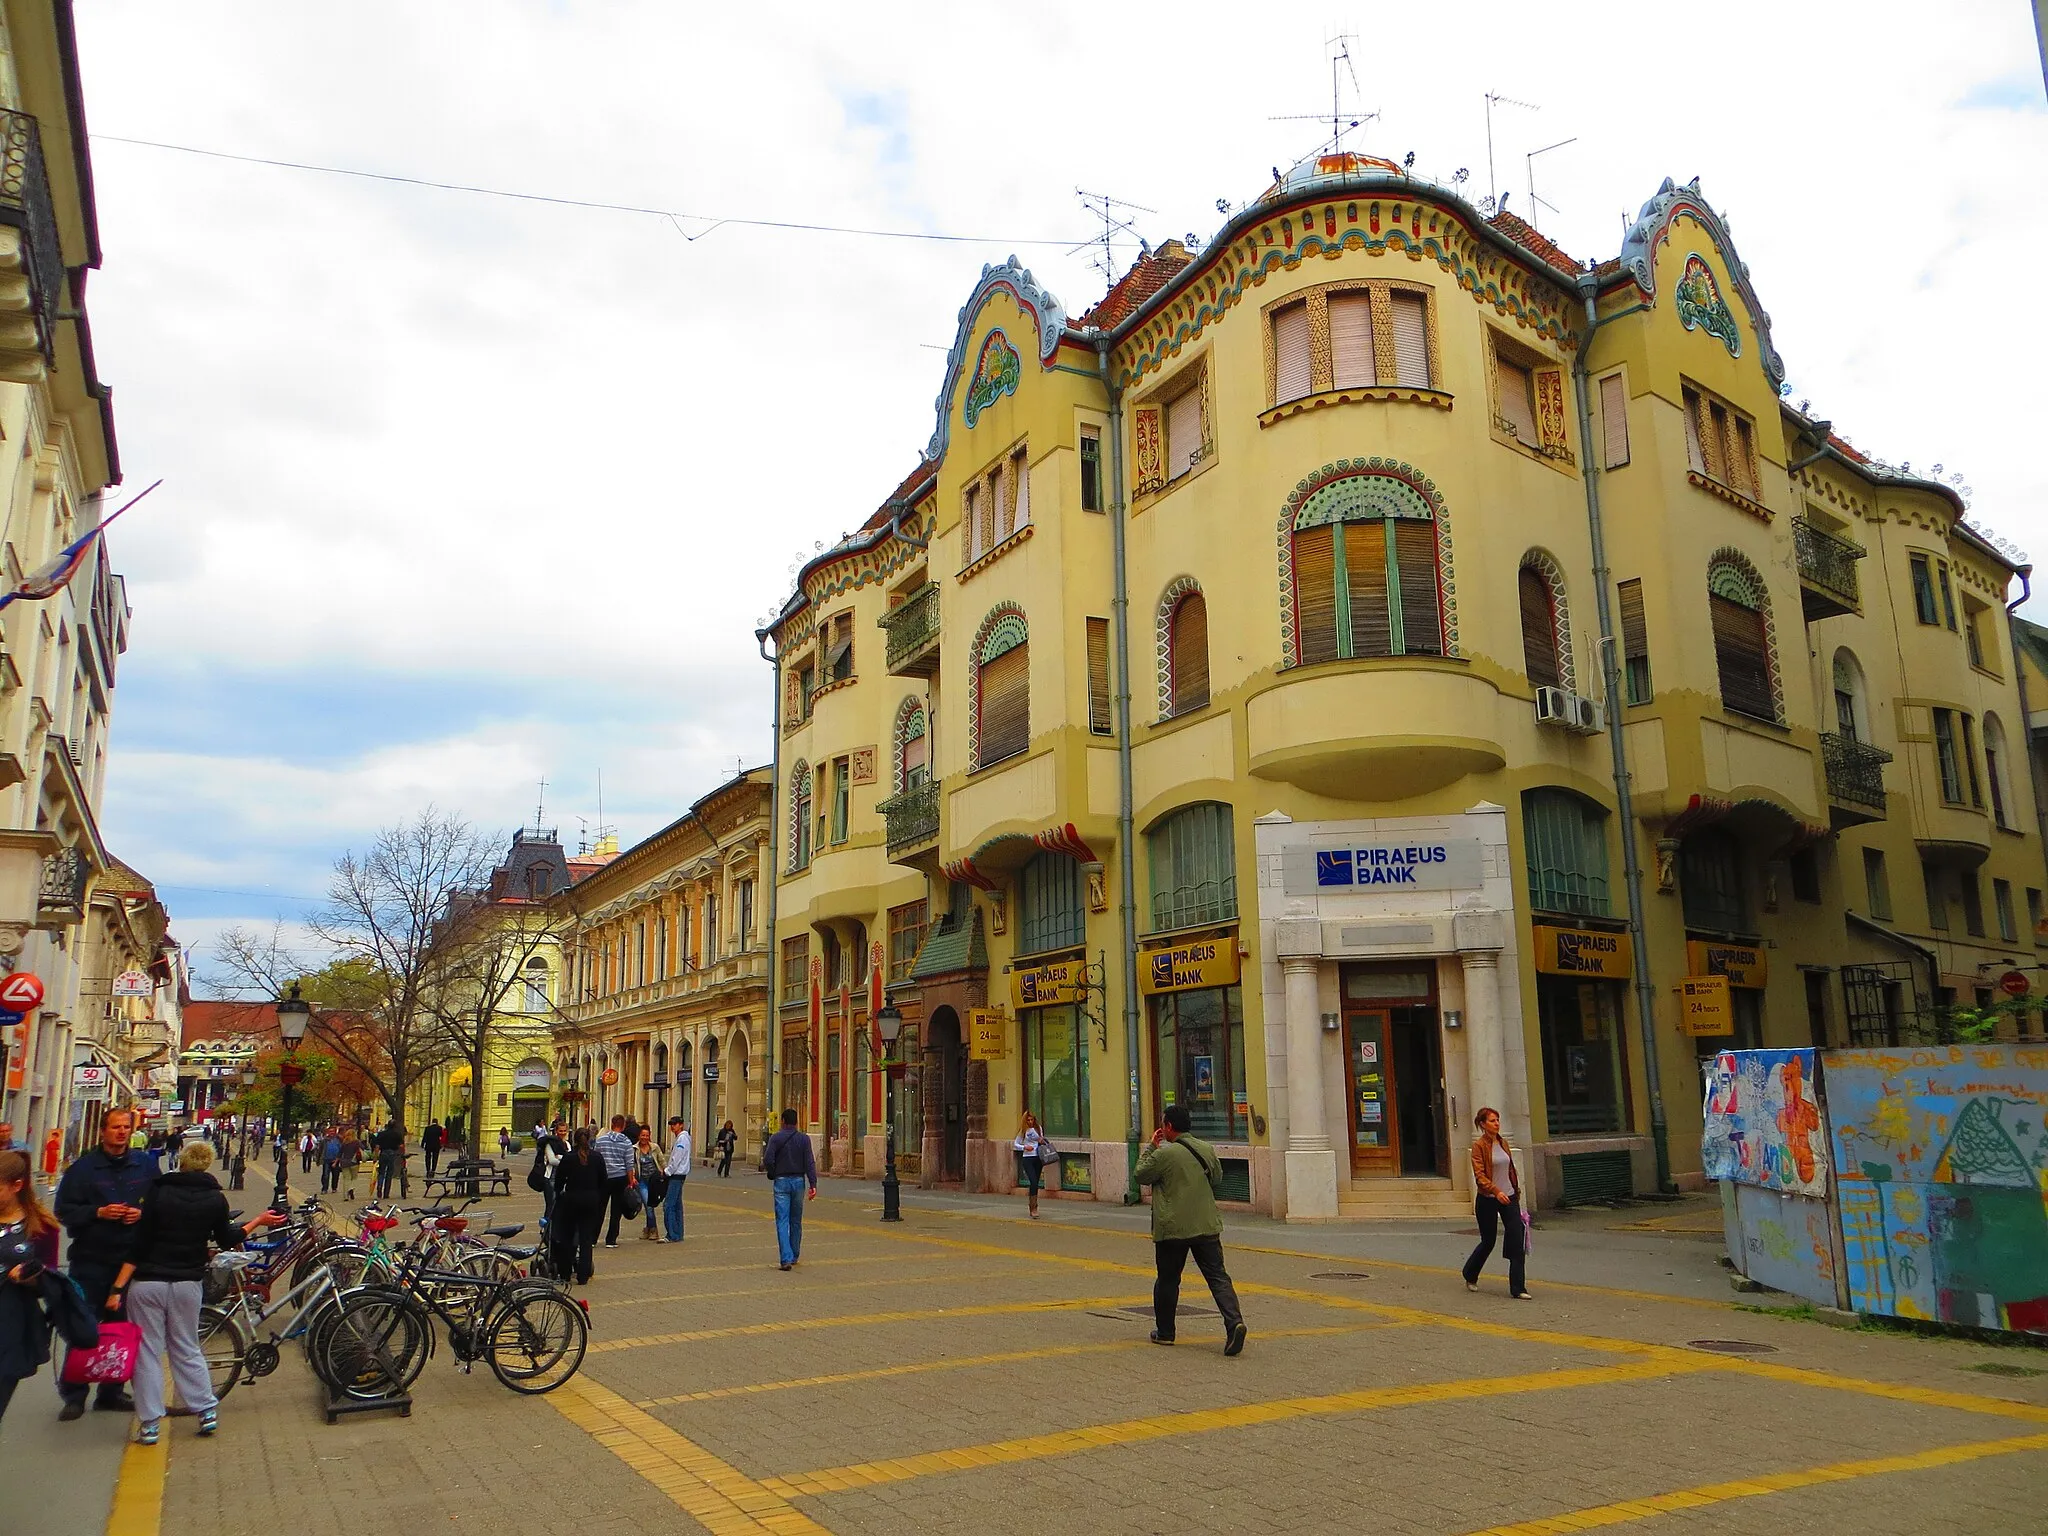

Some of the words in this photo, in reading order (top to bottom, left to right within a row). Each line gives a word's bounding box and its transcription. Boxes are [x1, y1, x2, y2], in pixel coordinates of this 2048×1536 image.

[1356, 846, 1446, 866] PIRAEUS
[1357, 866, 1416, 885] BANK
[1577, 934, 1617, 953] PIRAEUS
[1173, 945, 1216, 965] PIRAEUS
[1577, 957, 1604, 973] BANK
[1174, 969, 1203, 986] BANK
[1037, 987, 1059, 1002] BANK
[1691, 1003, 1702, 1013] 24
[1692, 1022, 1721, 1030] Bankomat
[980, 1031, 991, 1040] 24
[83, 1069, 99, 1079] 5D
